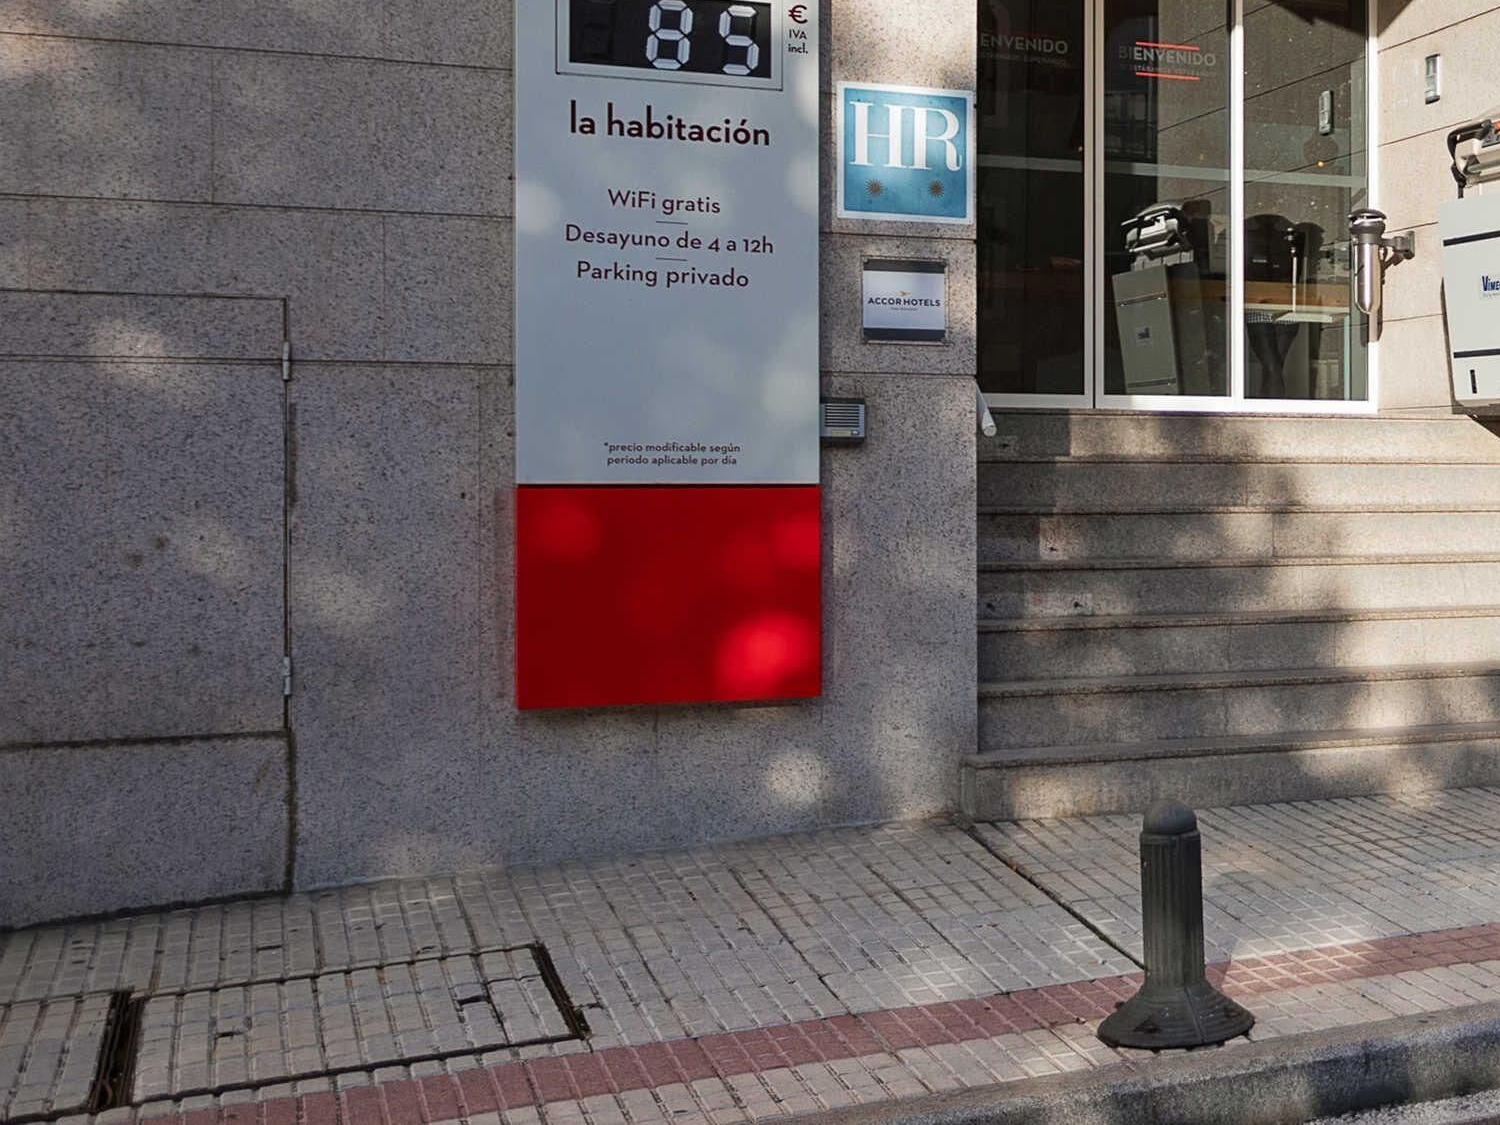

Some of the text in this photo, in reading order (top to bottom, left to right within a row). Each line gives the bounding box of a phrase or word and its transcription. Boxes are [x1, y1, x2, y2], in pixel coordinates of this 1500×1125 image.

[787, 4, 809, 24] €
[788, 28, 808, 40] IVA
[1118, 45, 1217, 67] BIENVENIDO
[569, 99, 771, 148] la habitación
[849, 101, 964, 172] HR
[607, 188, 721, 215] WiFi gratis
[565, 224, 775, 255] Desayuno de 4 a 12h
[575, 260, 750, 289] Parking privado
[645, 441, 707, 453] modificable
[709, 443, 741, 455] según
[651, 454, 698, 466] aplicable
[701, 457, 719, 467] por
[721, 455, 737, 465] día
